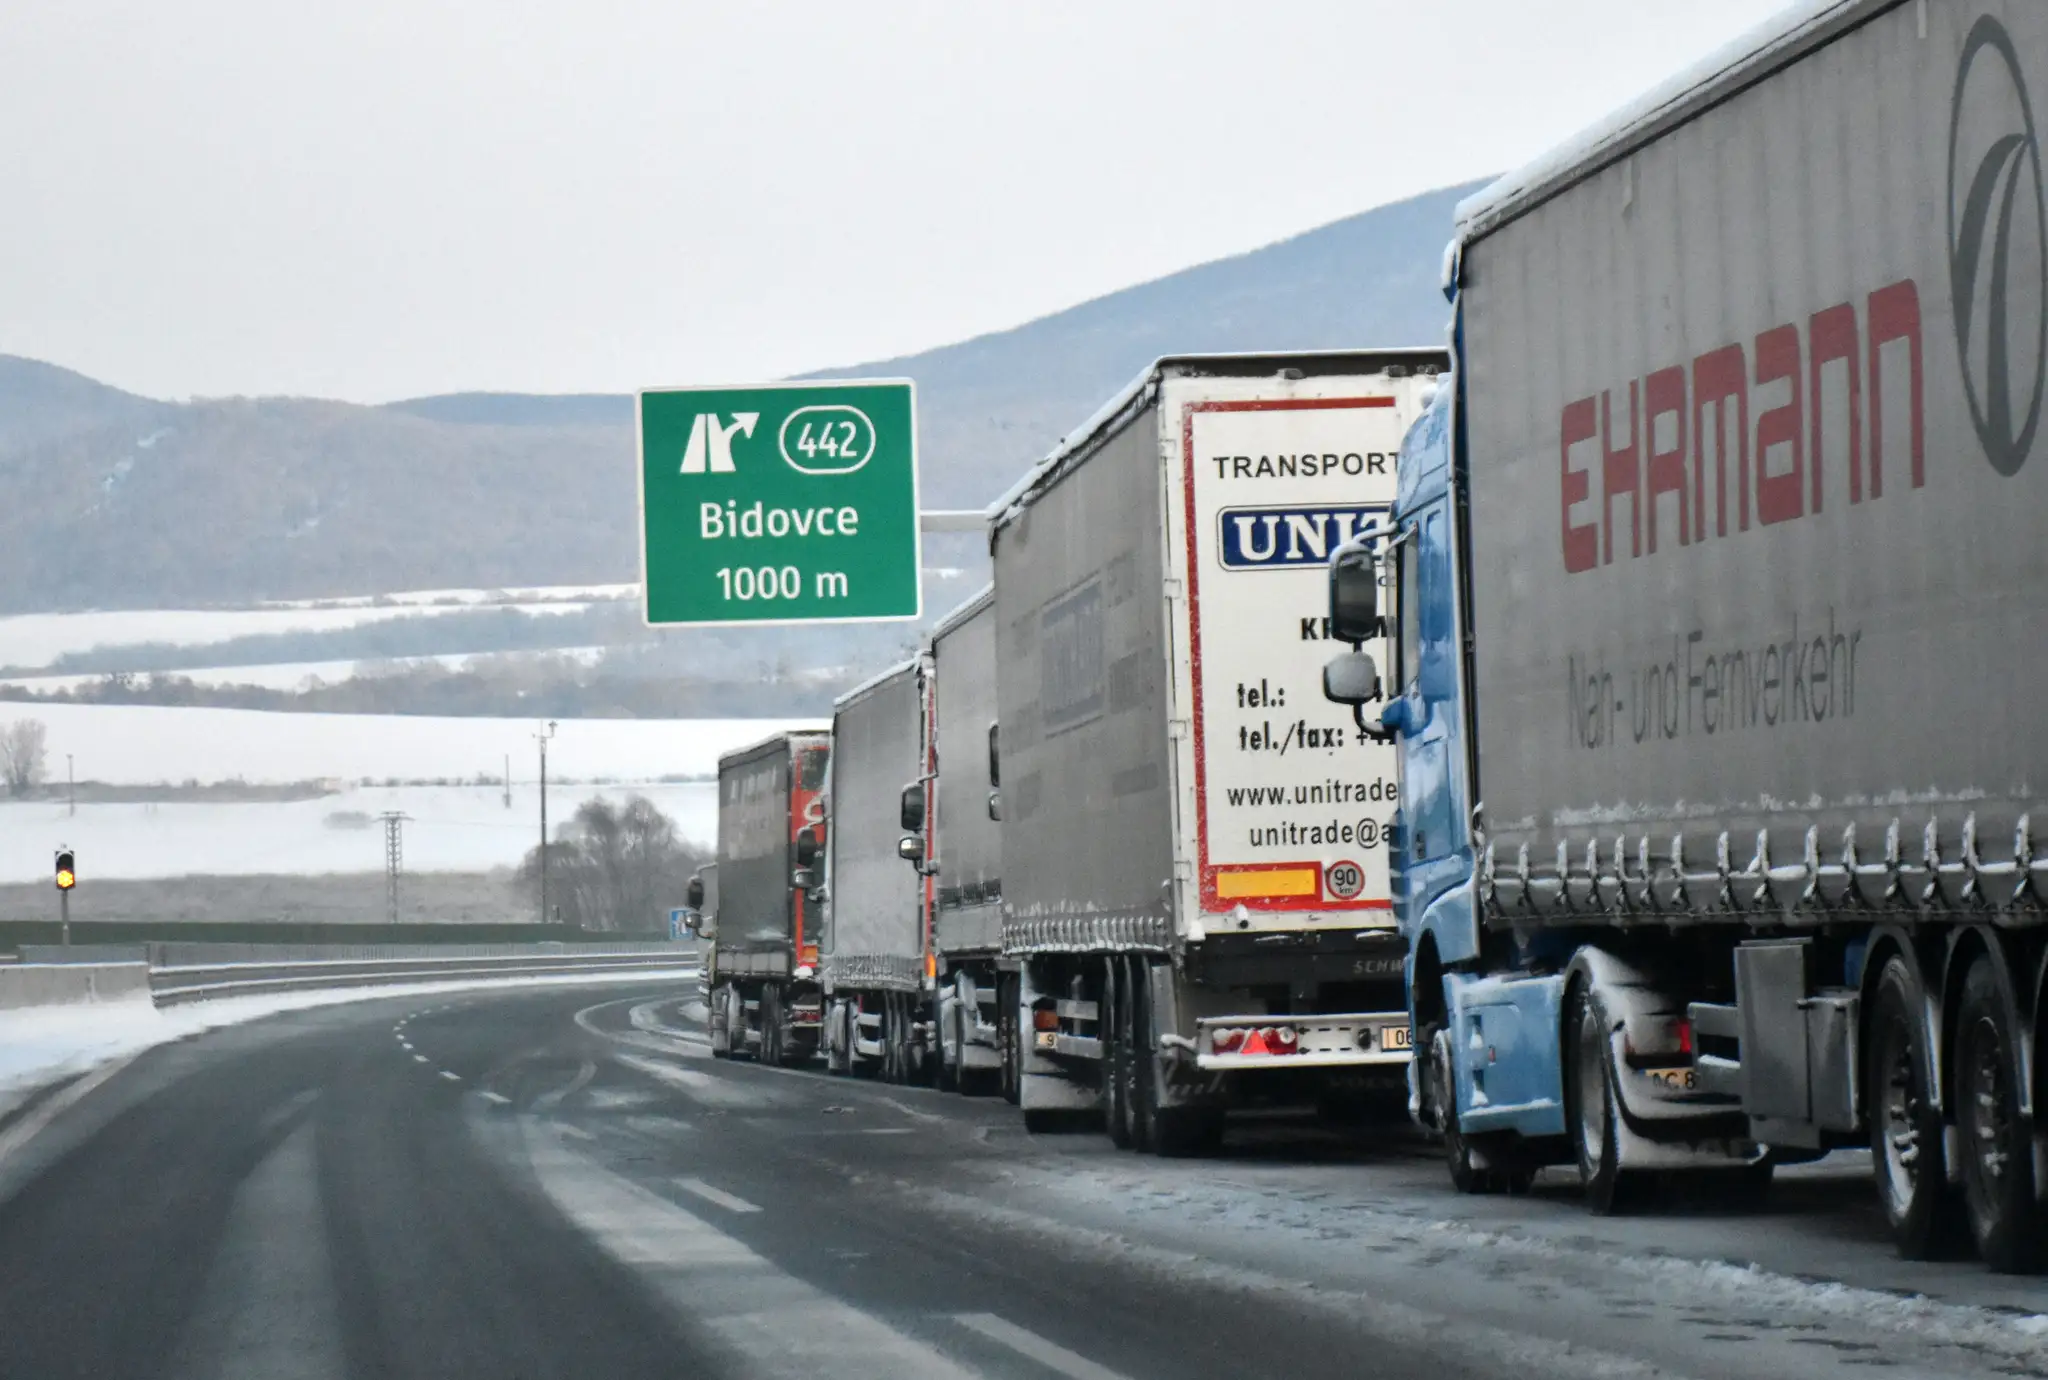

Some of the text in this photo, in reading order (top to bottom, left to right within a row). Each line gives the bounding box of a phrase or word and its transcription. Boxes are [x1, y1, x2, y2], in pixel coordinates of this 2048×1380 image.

[797, 421, 858, 458] 442
[700, 499, 859, 539] Bidovce
[716, 565, 848, 600] 1000 m
[1238, 678, 1286, 708] tel.:
[1631, 633, 1679, 744] und
[1686, 606, 1862, 735] Fernverkehr
[1239, 719, 1344, 756] tel./fax:
[1227, 777, 1398, 806] www.unitrade
[1334, 868, 1356, 886] 90
